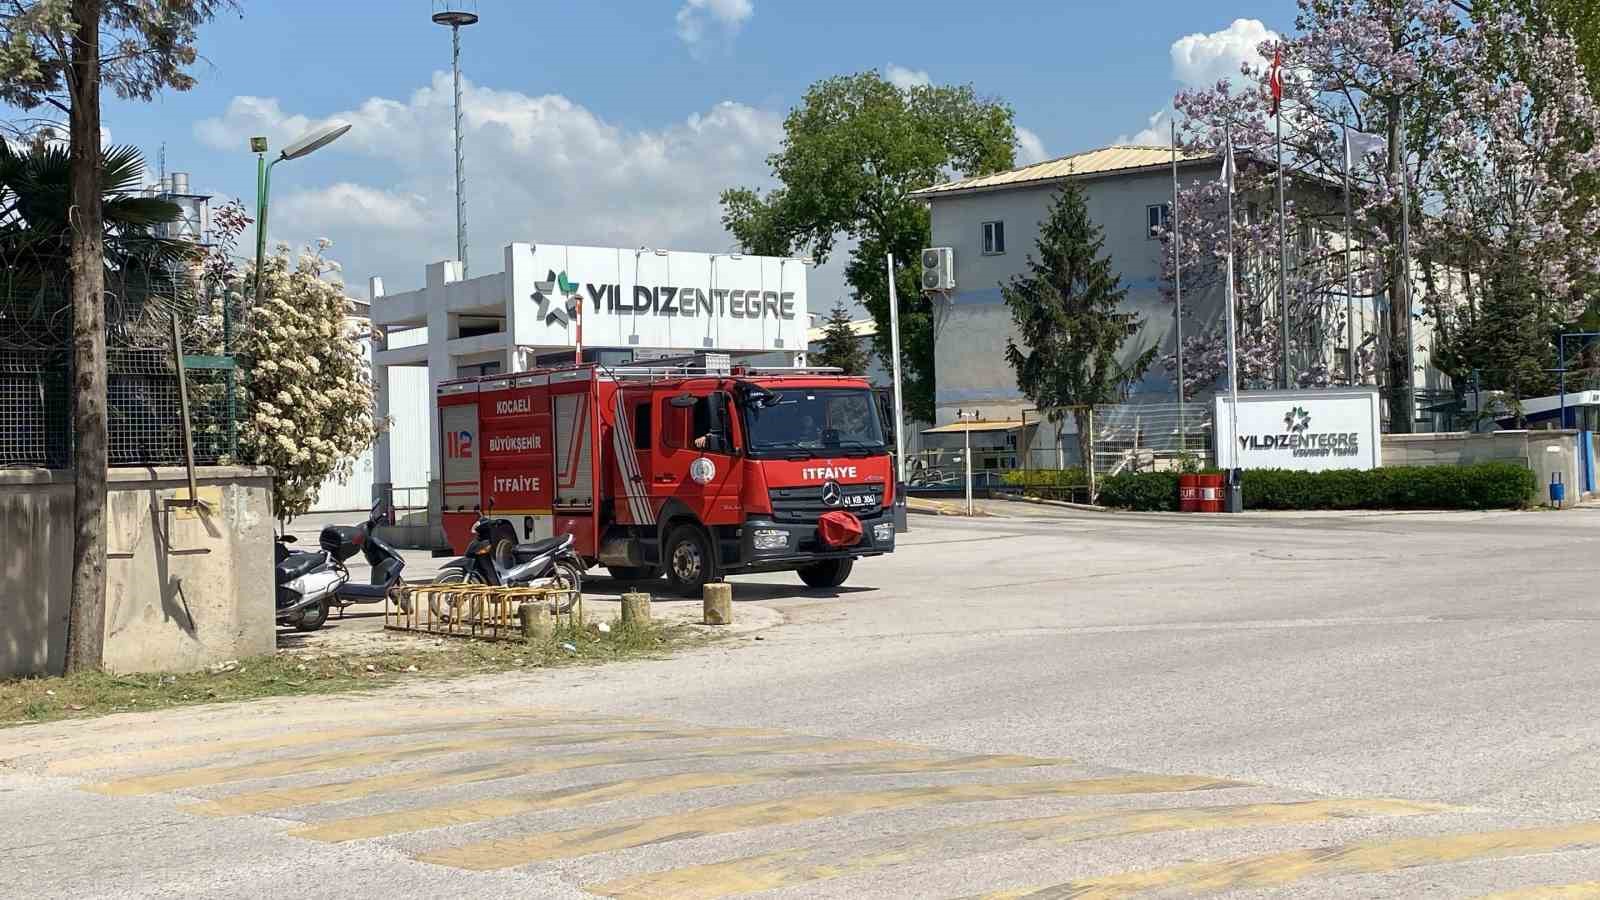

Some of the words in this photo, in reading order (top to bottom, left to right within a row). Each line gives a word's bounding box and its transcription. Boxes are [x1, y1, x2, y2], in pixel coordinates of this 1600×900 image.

[586, 283, 796, 320] YILDIZENTEGRE
[496, 395, 531, 414] KOCAELİ
[447, 431, 472, 458] 112
[489, 433, 541, 453] BÜYÜKŞEHİR
[1239, 432, 1359, 450] YILDIZENTEGRE
[802, 465, 857, 480] İTFAİYE
[494, 474, 540, 492] İTFAİYE
